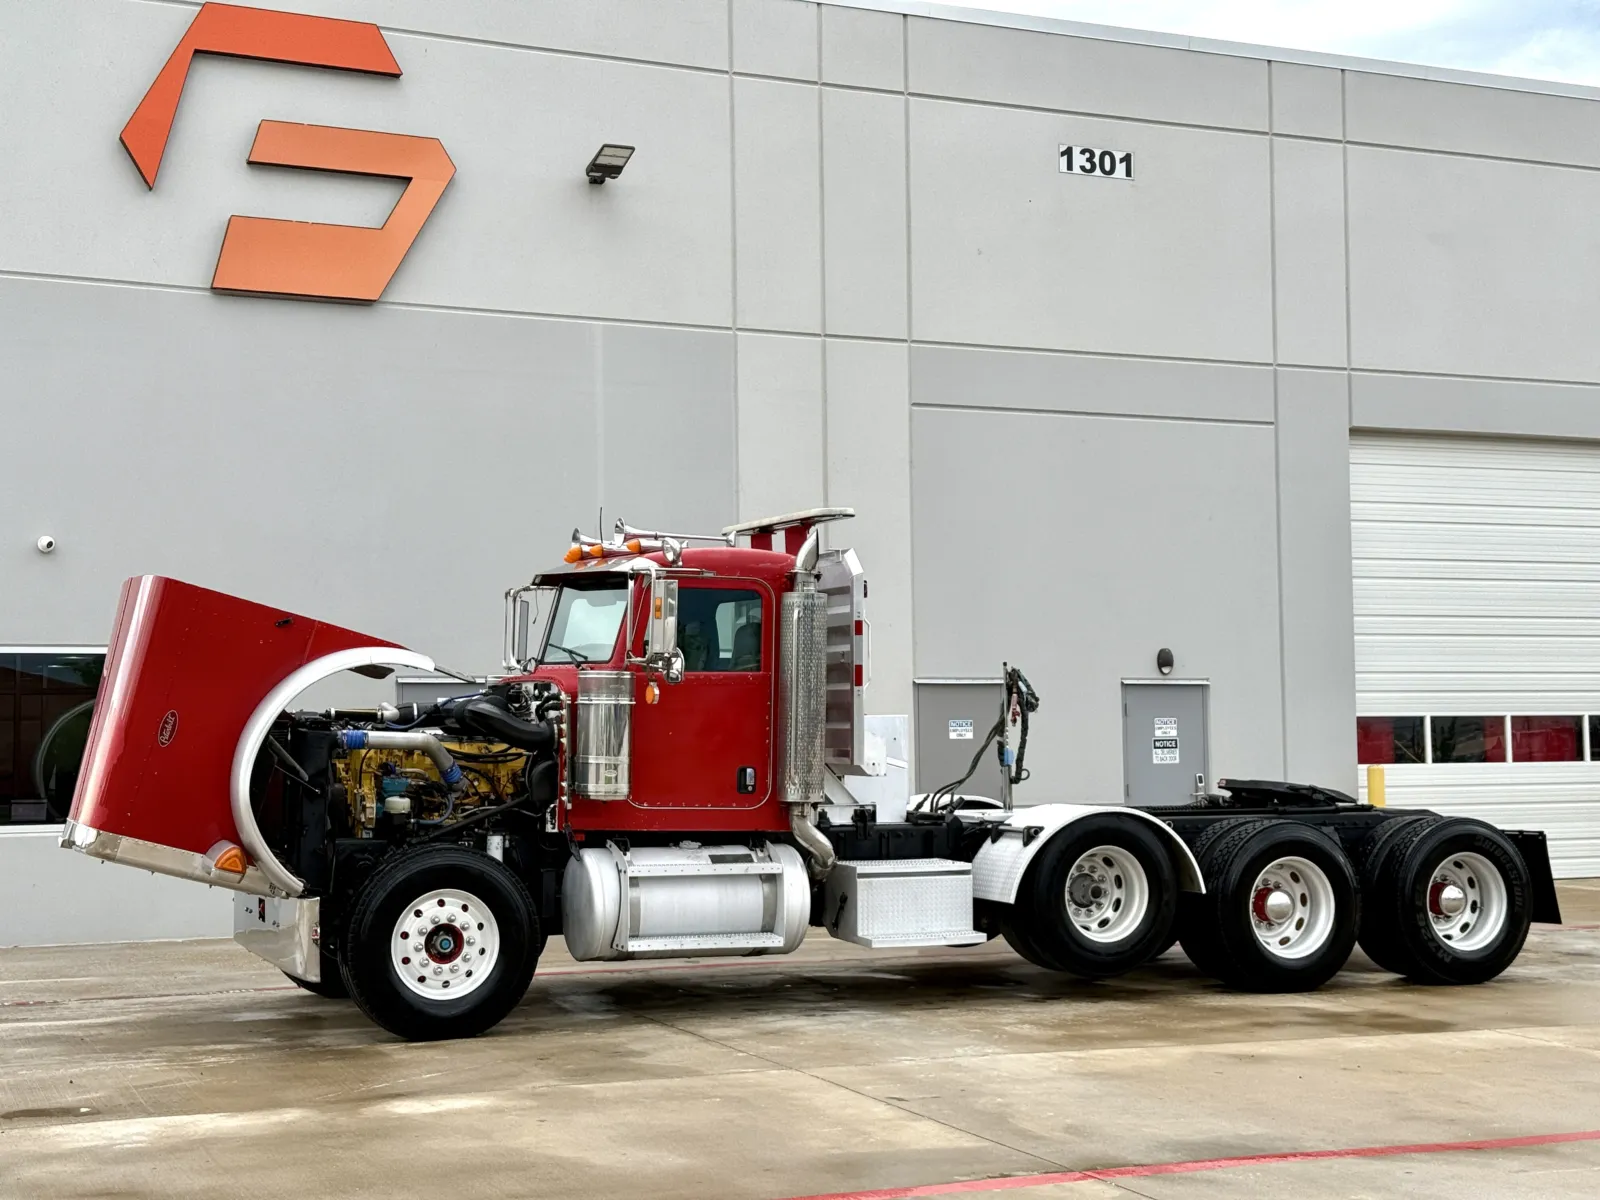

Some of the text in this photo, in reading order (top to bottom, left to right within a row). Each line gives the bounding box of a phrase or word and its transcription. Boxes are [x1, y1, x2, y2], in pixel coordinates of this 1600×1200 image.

[1061, 146, 1132, 178] 1301
[160, 712, 176, 744] Peterbilt
[1155, 740, 1176, 748] NOTICE
